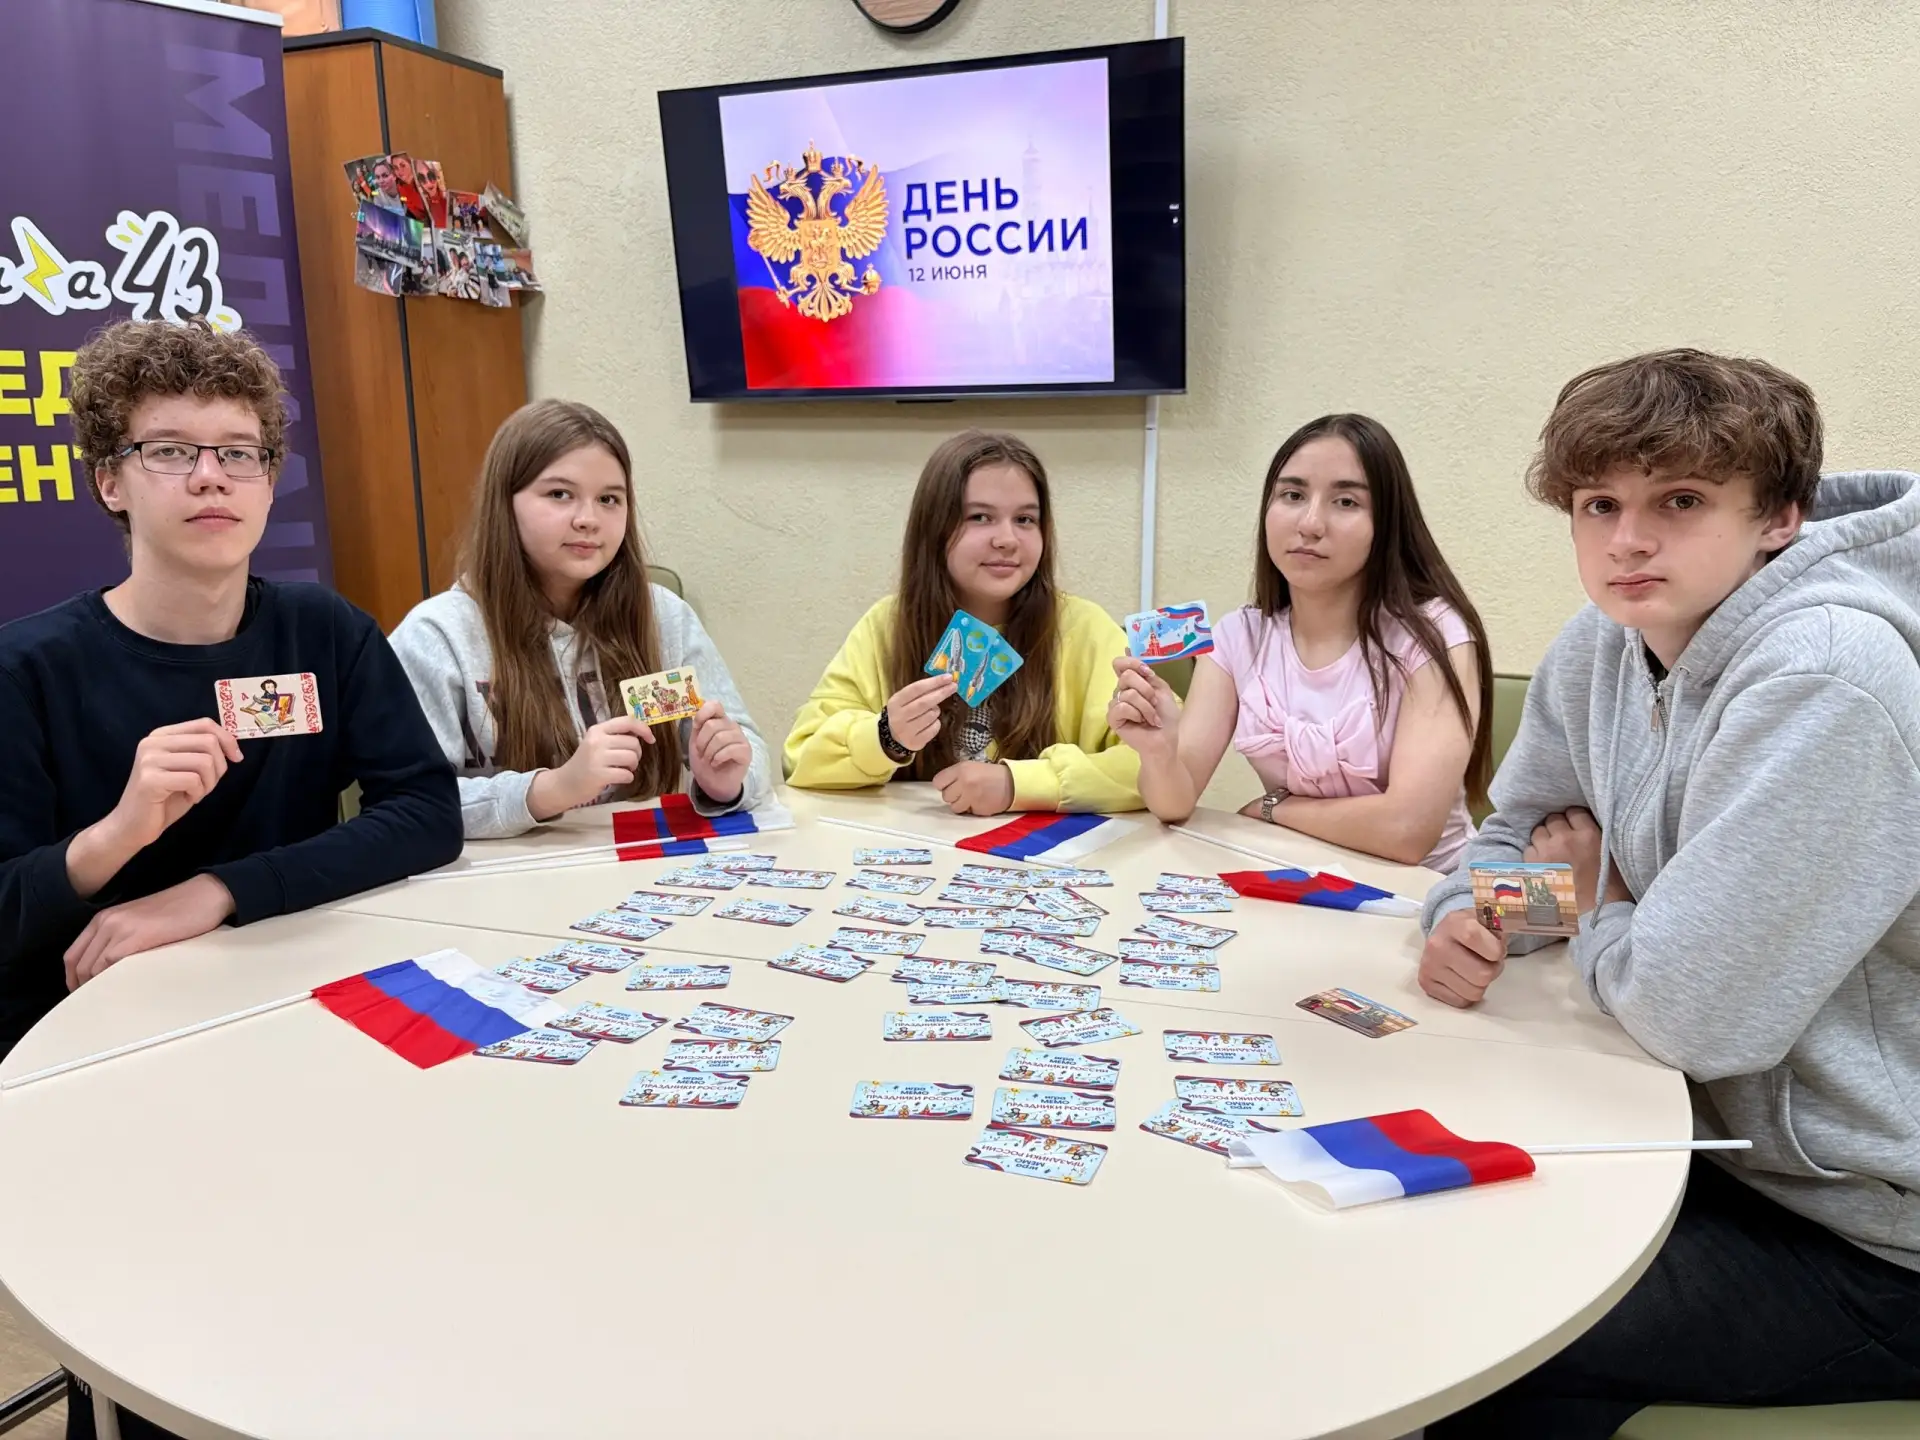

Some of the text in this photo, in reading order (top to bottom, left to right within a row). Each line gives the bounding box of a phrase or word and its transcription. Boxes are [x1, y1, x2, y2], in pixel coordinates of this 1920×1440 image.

[903, 177, 1018, 223] ДЕНЬ
[905, 217, 1087, 260] РОССИИ
[908, 264, 987, 281] 12 ИЮНЯ
[1015, 1060, 1109, 1074] ПРАЗДНИКИ РОССИИ
[1006, 1102, 1062, 1110] ПРАЗДНИКИ
[1224, 1130, 1250, 1139] РОСС
